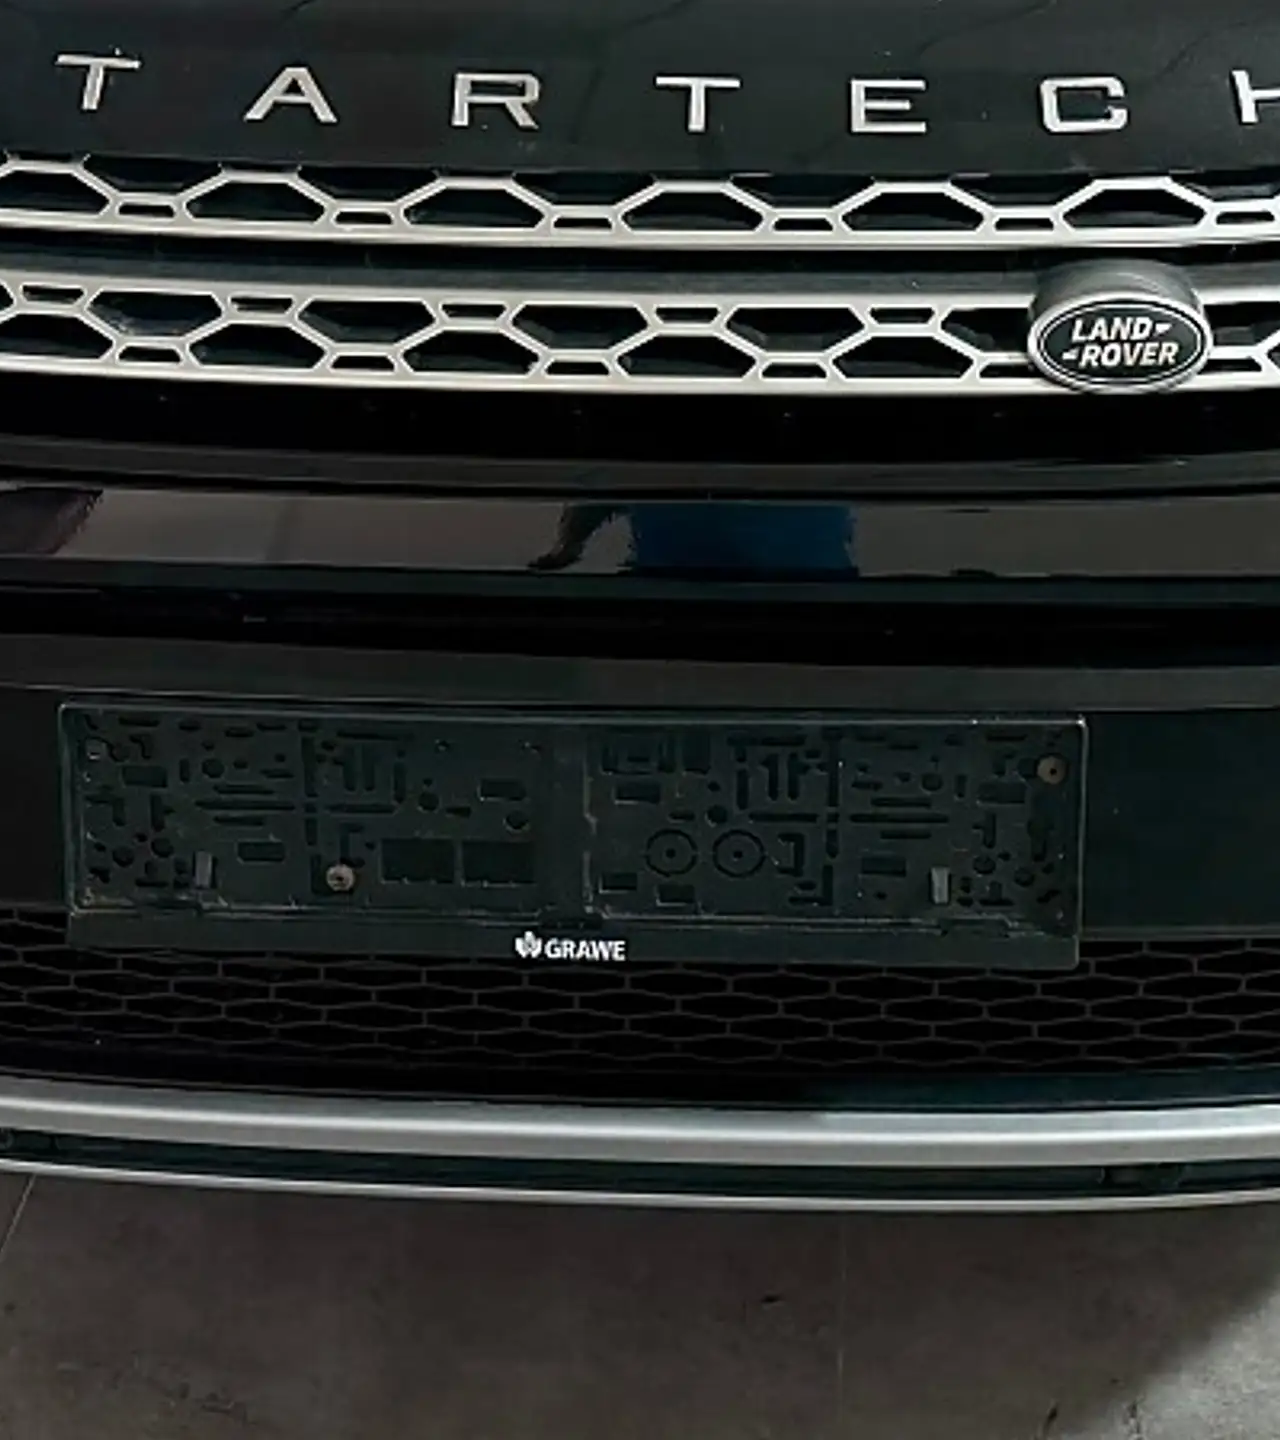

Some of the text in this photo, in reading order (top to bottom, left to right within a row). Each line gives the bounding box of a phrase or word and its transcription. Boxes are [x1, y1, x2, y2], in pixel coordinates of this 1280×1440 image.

[1071, 316, 1153, 342] LAND
[1078, 341, 1180, 368] ROVER
[544, 937, 626, 961] GRAWE
